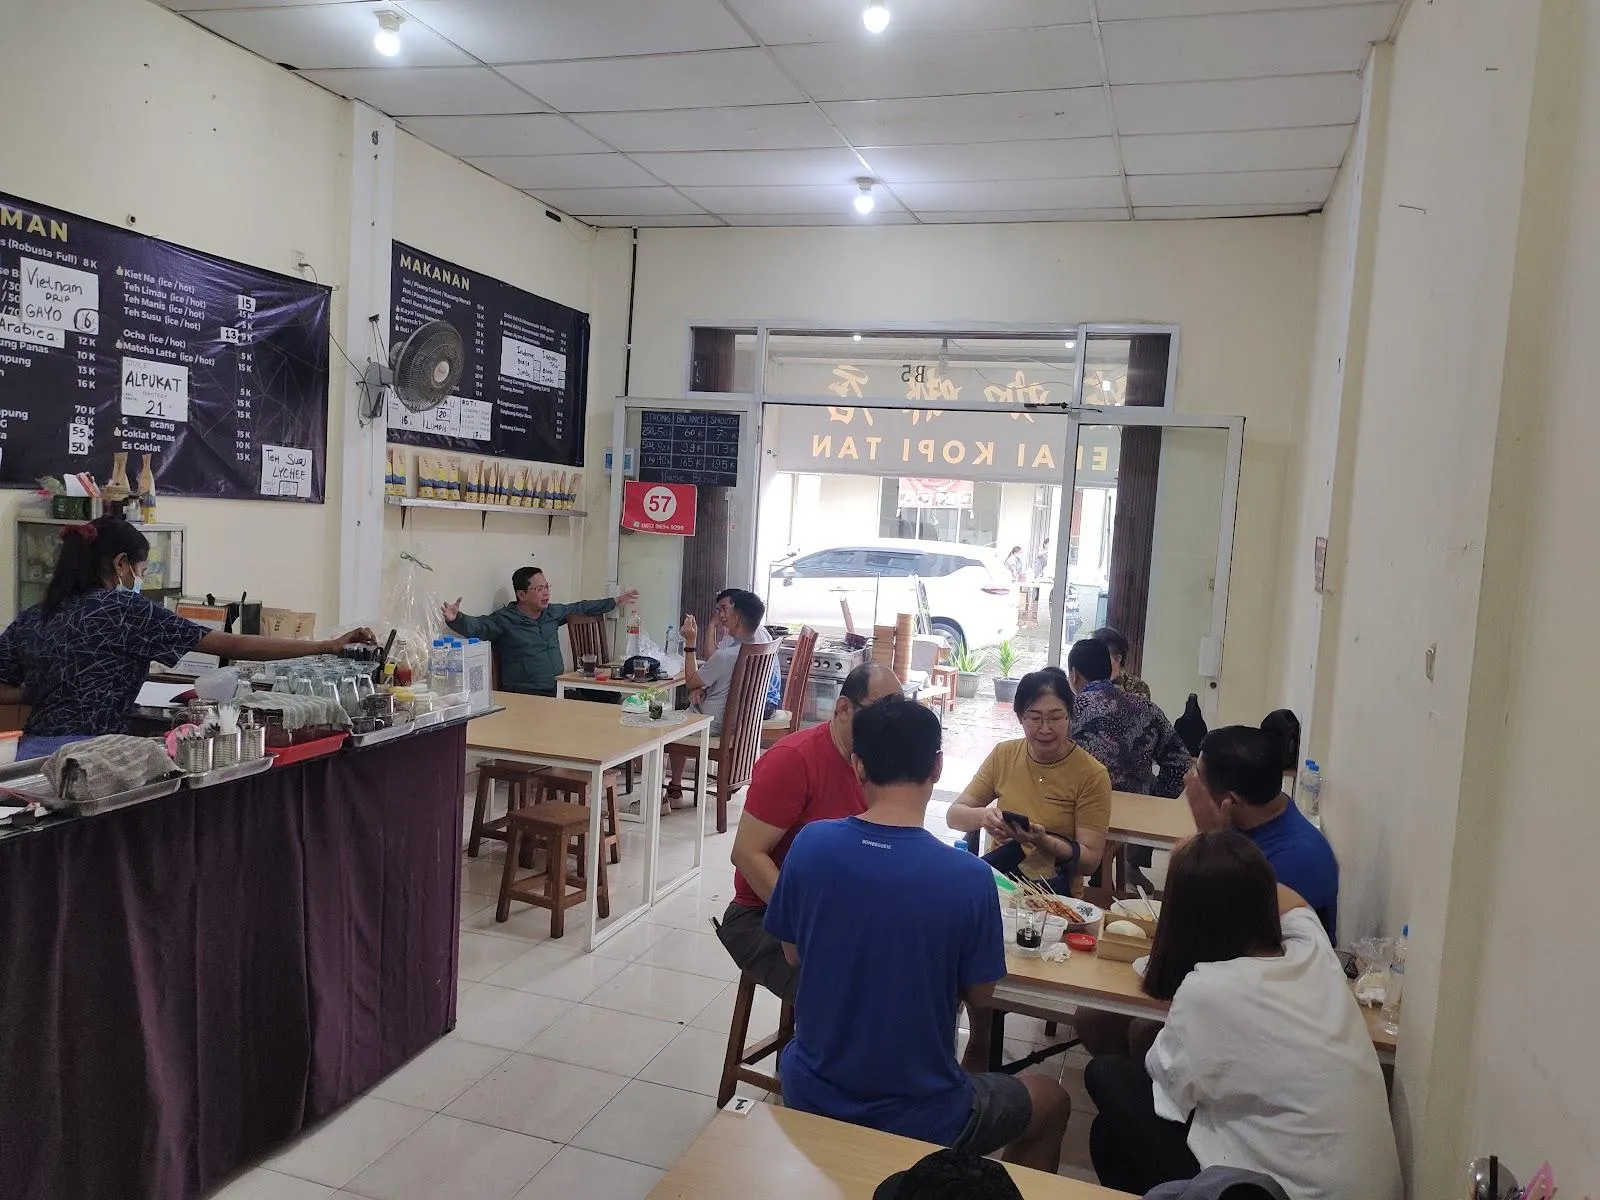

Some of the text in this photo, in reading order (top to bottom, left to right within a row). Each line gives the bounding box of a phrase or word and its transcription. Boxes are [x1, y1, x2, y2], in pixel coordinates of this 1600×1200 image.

[8, 239, 52, 258] (Robusta
[56, 251, 77, 265] Full)
[83, 259, 89, 267] 8
[91, 260, 97, 270] K
[400, 253, 470, 291] MAKANAN
[124, 281, 140, 292] Teh
[142, 285, 167, 299] Limau
[143, 273, 155, 284] Na
[242, 297, 252, 309] 15
[124, 293, 140, 305] Teh
[141, 297, 166, 311] Manis
[26, 304, 62, 321] GAYO
[123, 306, 140, 317] Teh
[141, 310, 161, 322] Susu
[225, 329, 237, 339] 13
[78, 337, 87, 345] 12
[89, 338, 96, 347] K
[123, 329, 145, 341] Ocha
[77, 351, 87, 359] 10
[89, 353, 96, 361] K
[123, 341, 154, 355] Matcha
[156, 346, 177, 359] Latte
[238, 363, 246, 371] 15
[246, 365, 252, 373] K
[89, 367, 96, 376] K
[78, 379, 96, 389] 16 K
[125, 370, 182, 393] ALPUKAT
[245, 389, 251, 397] K
[0, 405, 96, 420] pung 70 K
[145, 400, 166, 417] 21
[75, 416, 86, 424] 65
[87, 417, 94, 426] K
[150, 421, 175, 432] acang
[73, 427, 86, 437] 55
[122, 429, 150, 440] Coklat
[151, 431, 176, 442] Panas
[245, 431, 251, 439] K
[122, 442, 132, 450] Es
[133, 443, 161, 452] Coklat
[236, 441, 244, 449] 10
[648, 495, 672, 512] 57
